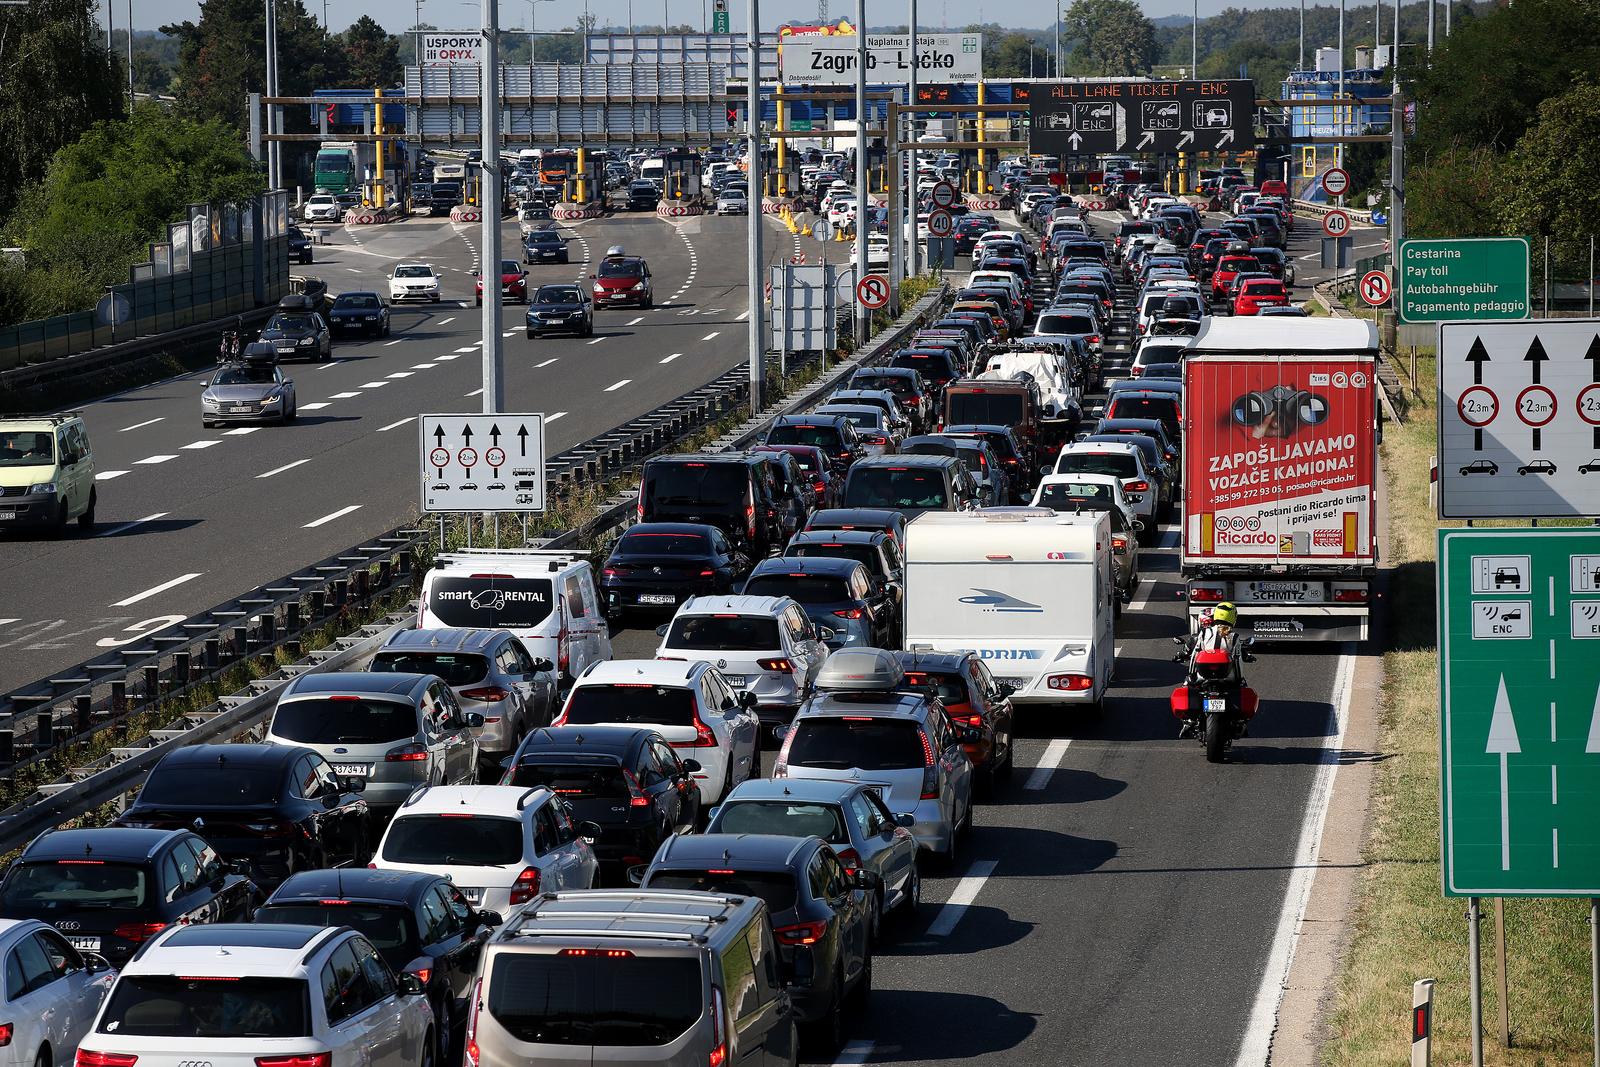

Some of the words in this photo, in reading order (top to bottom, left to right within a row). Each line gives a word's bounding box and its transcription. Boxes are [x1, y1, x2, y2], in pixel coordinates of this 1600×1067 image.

[426, 38, 482, 48] USPORYX
[868, 37, 903, 47] Naplatna
[906, 37, 935, 47] pstaja
[427, 50, 436, 59] ili
[439, 49, 475, 59] ORYX.
[1051, 85, 1079, 98] ALL
[1085, 84, 1121, 97] LANE
[1128, 83, 1180, 96] TICKET
[1201, 82, 1229, 95] ENC
[1082, 119, 1107, 129] ENC
[1149, 118, 1173, 128] ENC
[934, 216, 948, 230] 40
[1329, 217, 1344, 230] 40
[1406, 248, 1461, 259] Cestarina
[1407, 266, 1428, 279] Pay
[1430, 265, 1449, 276] toll
[1406, 283, 1499, 296] Autobahngebühr
[1407, 301, 1471, 315] Pagamento
[1473, 300, 1525, 313] pedaggio
[1209, 433, 1355, 473] ZAPOŠLJAVAMO
[1209, 466, 1270, 491] VOZAČE
[1274, 453, 1355, 480] KAMIONA!
[1209, 489, 1230, 504] +385
[1231, 492, 1241, 501] 99
[1243, 489, 1258, 498] 272
[1260, 487, 1270, 496] 93
[1286, 473, 1356, 493] posao@ricardo.hr
[1258, 505, 1292, 519] Postani
[1293, 503, 1308, 513] dio
[1309, 497, 1344, 510] Ricardo
[1346, 494, 1366, 504] tima
[1287, 516, 1290, 525] i
[1292, 510, 1321, 525] prijavi
[1323, 508, 1337, 518] se!
[1217, 520, 1228, 528] 70
[1232, 520, 1243, 528] 80
[1248, 520, 1259, 528] 90
[1217, 531, 1277, 544] Ricardo
[438, 590, 473, 600] smart
[504, 591, 545, 602] RENTAL
[1253, 592, 1305, 600] SCHMITZ
[1492, 625, 1513, 633] ENC
